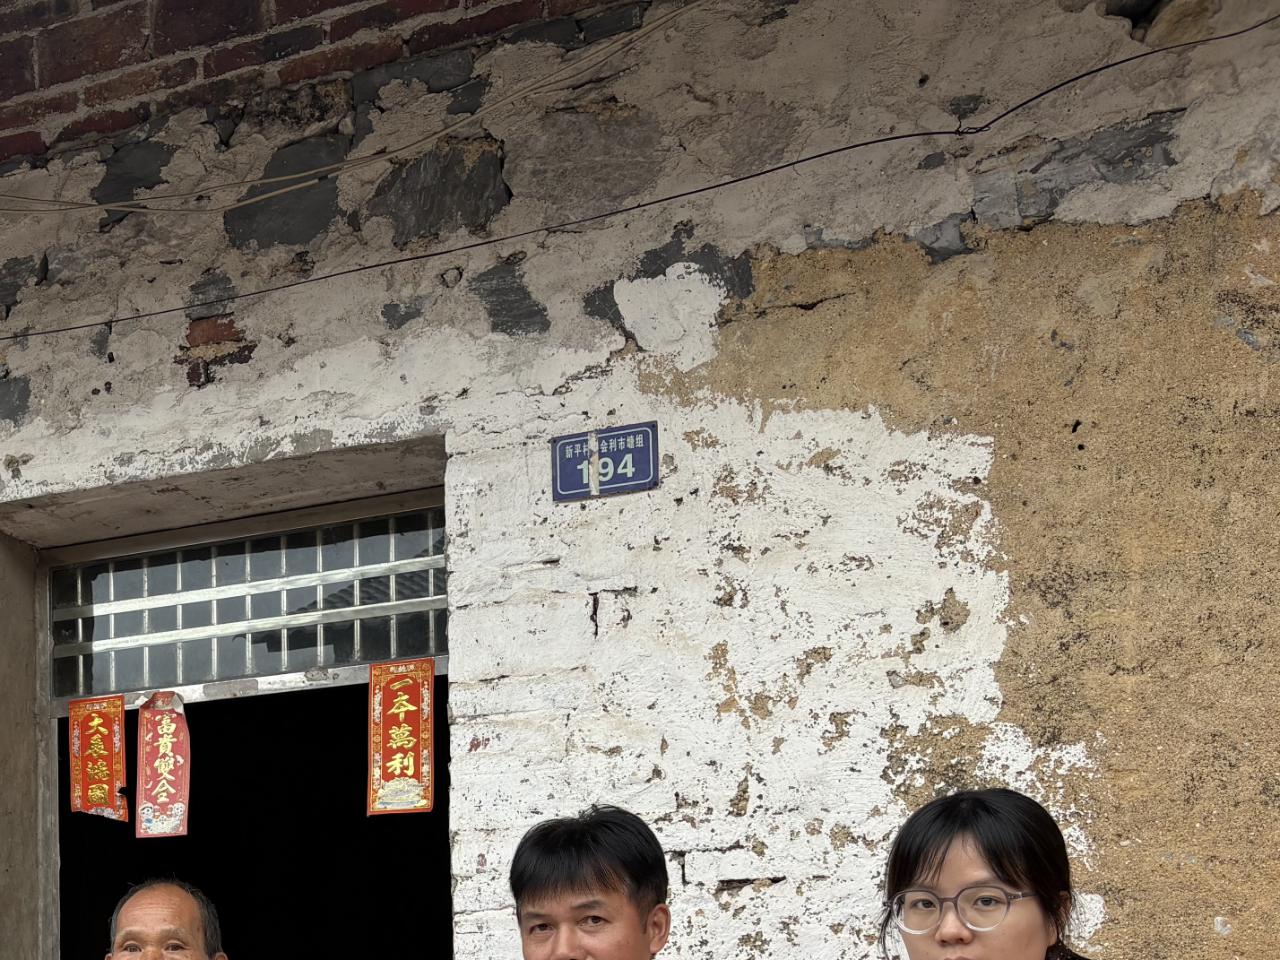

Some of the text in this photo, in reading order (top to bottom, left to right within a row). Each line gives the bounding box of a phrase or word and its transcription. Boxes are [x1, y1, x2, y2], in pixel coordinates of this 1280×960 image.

[576, 453, 636, 484] 194
[386, 678, 418, 776] 一本萬利
